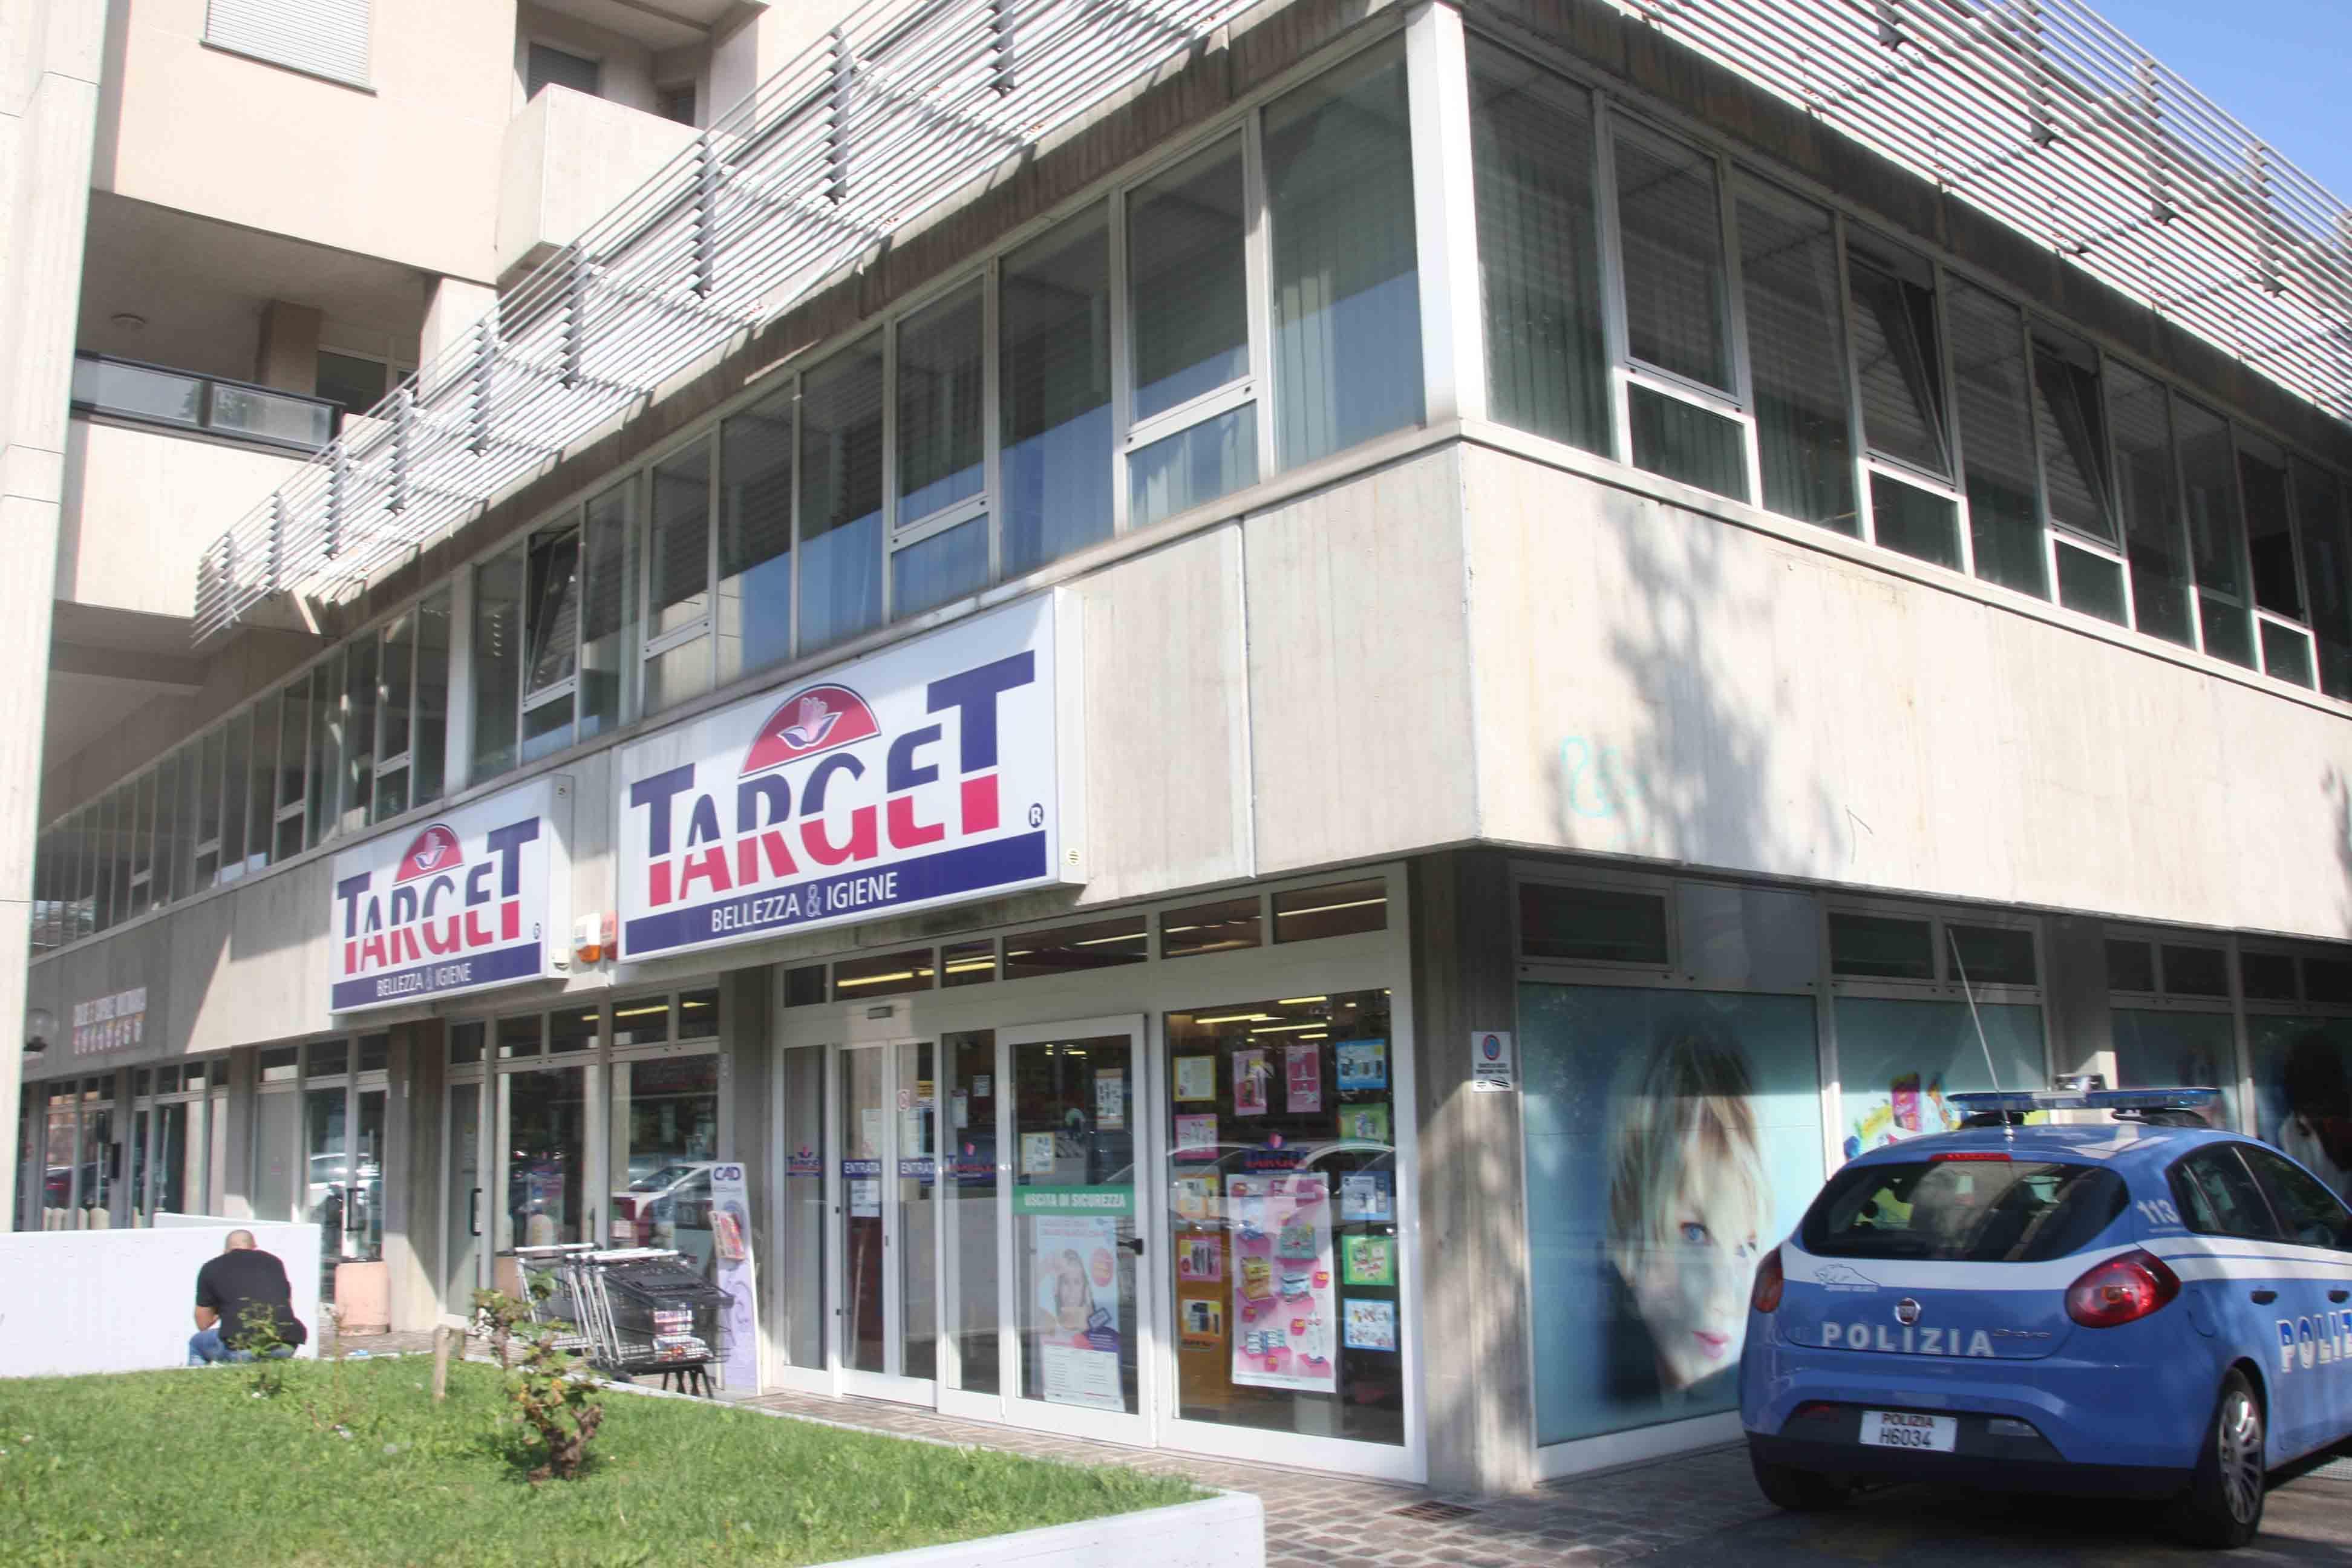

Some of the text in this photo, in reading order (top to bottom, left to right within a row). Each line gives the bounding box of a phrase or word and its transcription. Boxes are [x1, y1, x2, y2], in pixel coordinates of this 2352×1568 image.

[631, 650, 1035, 907] TARGET
[338, 816, 540, 975] TARGET
[711, 872, 898, 932] BELLEZZA & IGIENE
[377, 973, 423, 997] BELLEZZA
[436, 962, 472, 987] IGIENE
[843, 1162, 881, 1174] ENTRATA
[900, 1162, 935, 1174] ENTRAT
[1024, 1194, 1057, 1206] USCITA
[1071, 1194, 1126, 1208] SICUREZZA
[2137, 1200, 2181, 1224] 113
[1821, 1321, 1994, 1357] POLIZIA
[1883, 1413, 1935, 1428] POLIZIA
[1880, 1427, 1932, 1446] H6034
